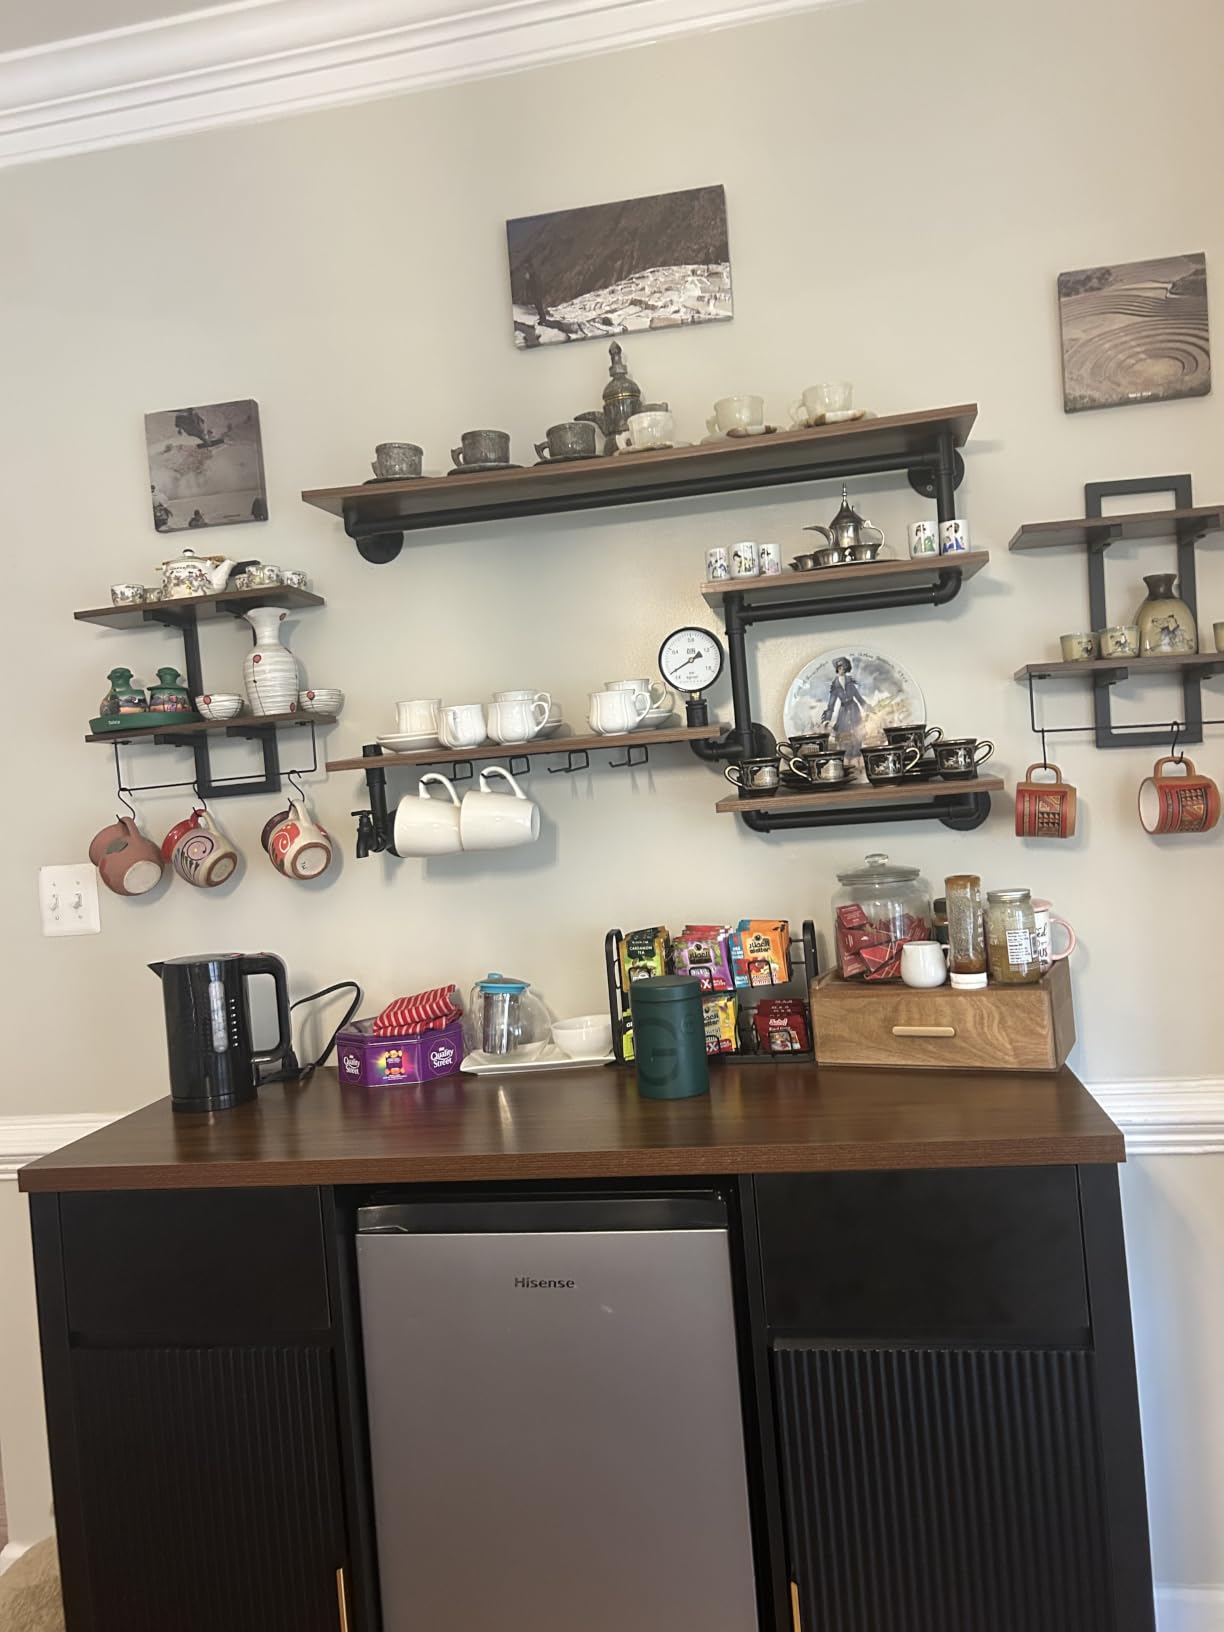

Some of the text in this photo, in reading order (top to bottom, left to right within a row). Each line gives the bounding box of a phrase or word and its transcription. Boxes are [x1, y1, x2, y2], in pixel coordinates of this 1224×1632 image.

[430, 1049, 454, 1061] Quality
[343, 1056, 360, 1068] Quality
[433, 1058, 453, 1068] Street
[514, 1277, 575, 1289] Hisense
